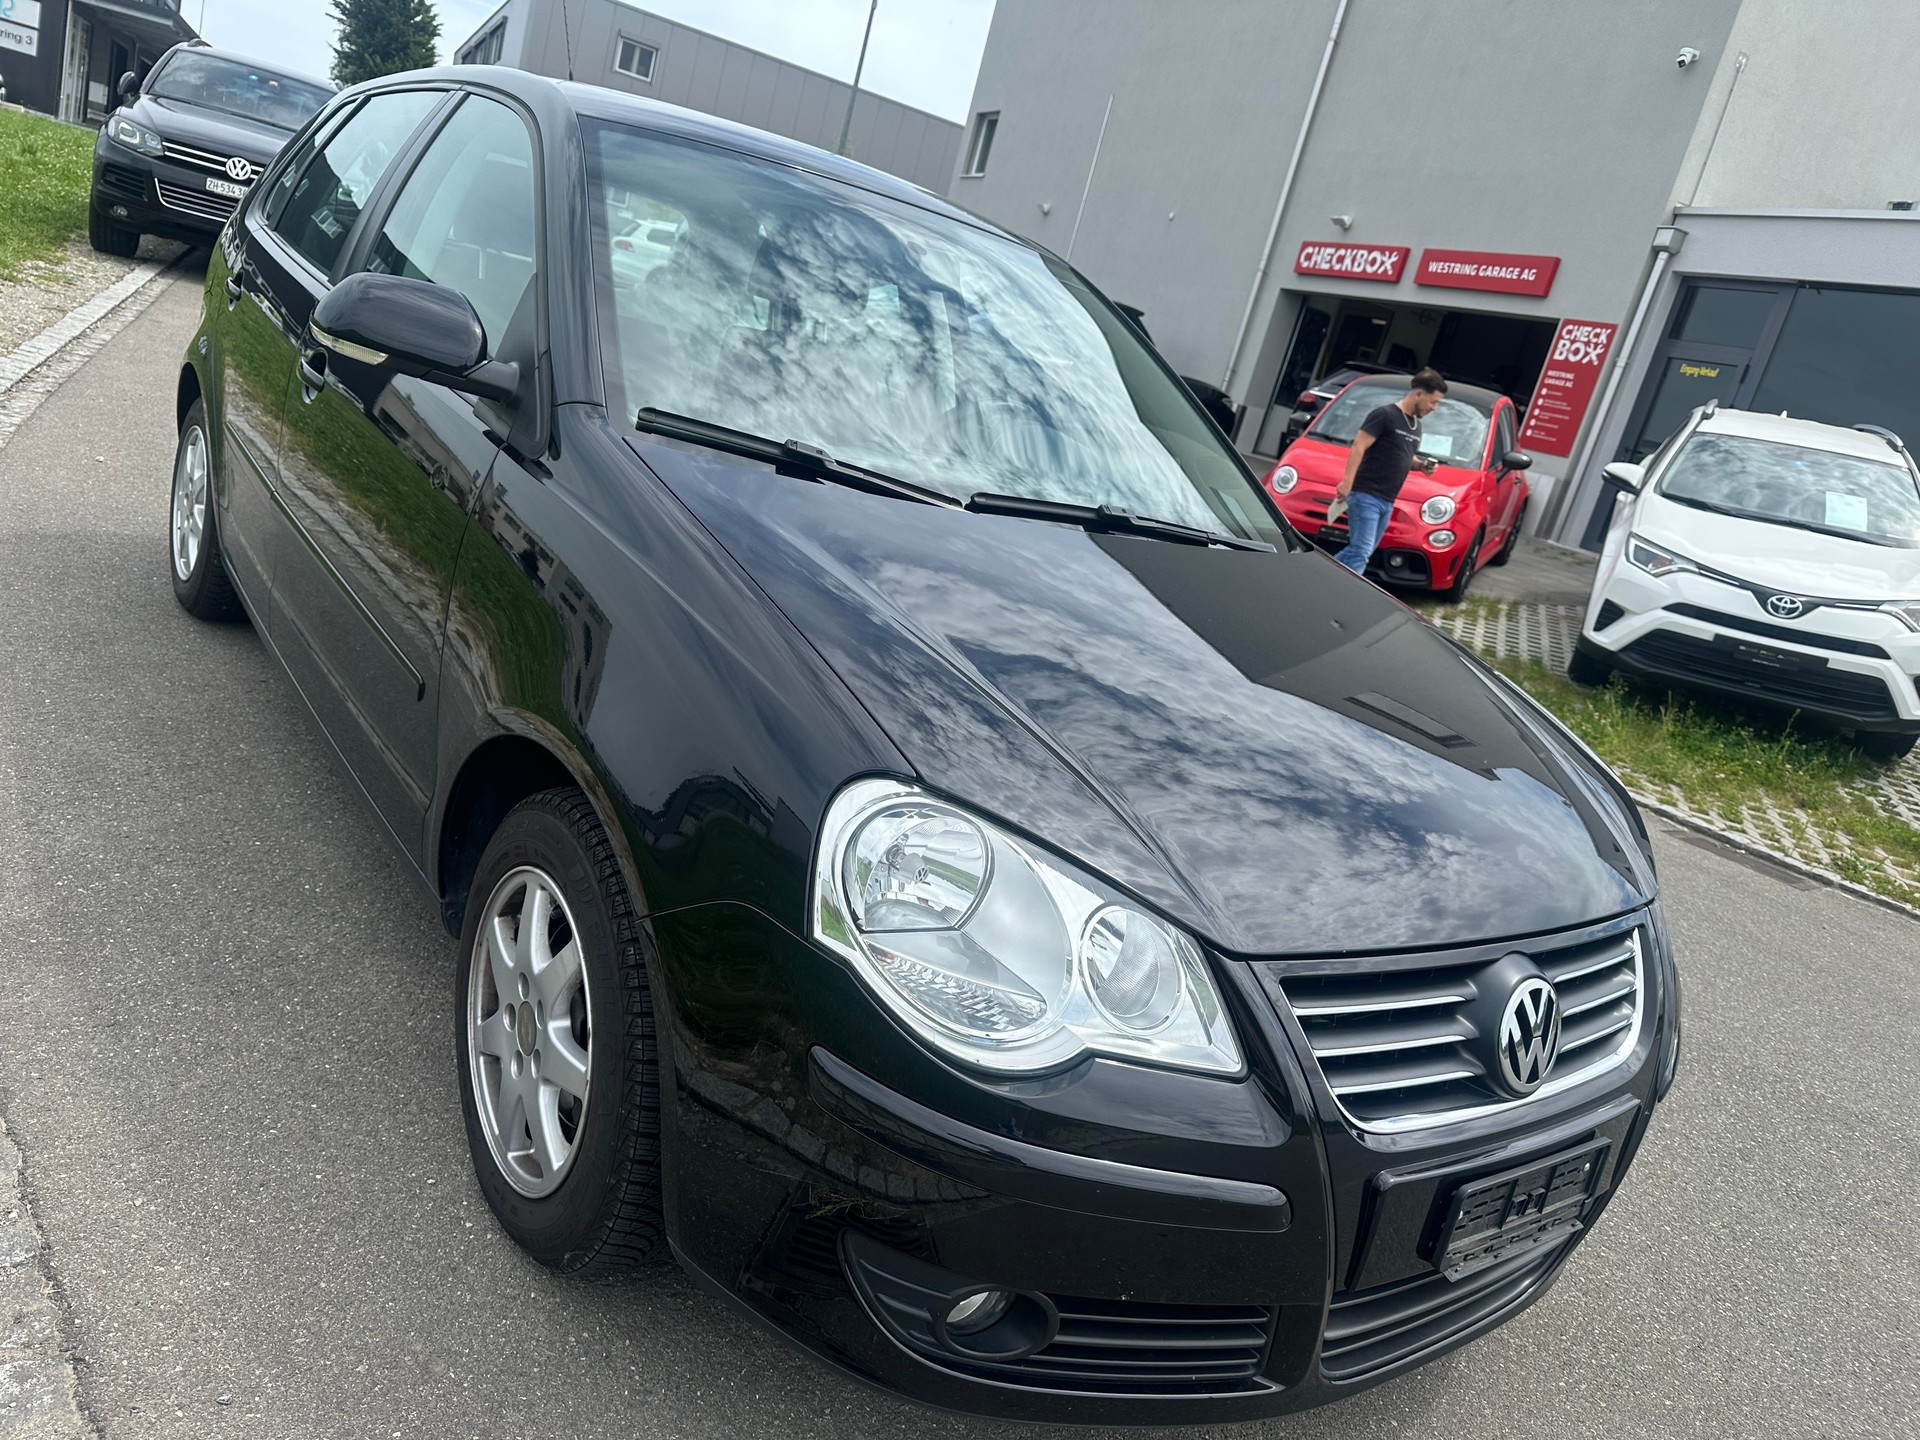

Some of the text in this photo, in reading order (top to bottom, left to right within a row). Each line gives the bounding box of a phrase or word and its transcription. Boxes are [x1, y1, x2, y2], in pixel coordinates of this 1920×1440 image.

[25, 35, 33, 45] 3
[1300, 246, 1399, 275] CHECKBOX
[1428, 261, 1537, 281] WESTRING GARAGE AG
[1561, 325, 1611, 344] CHECK
[1553, 339, 1605, 365] BOX
